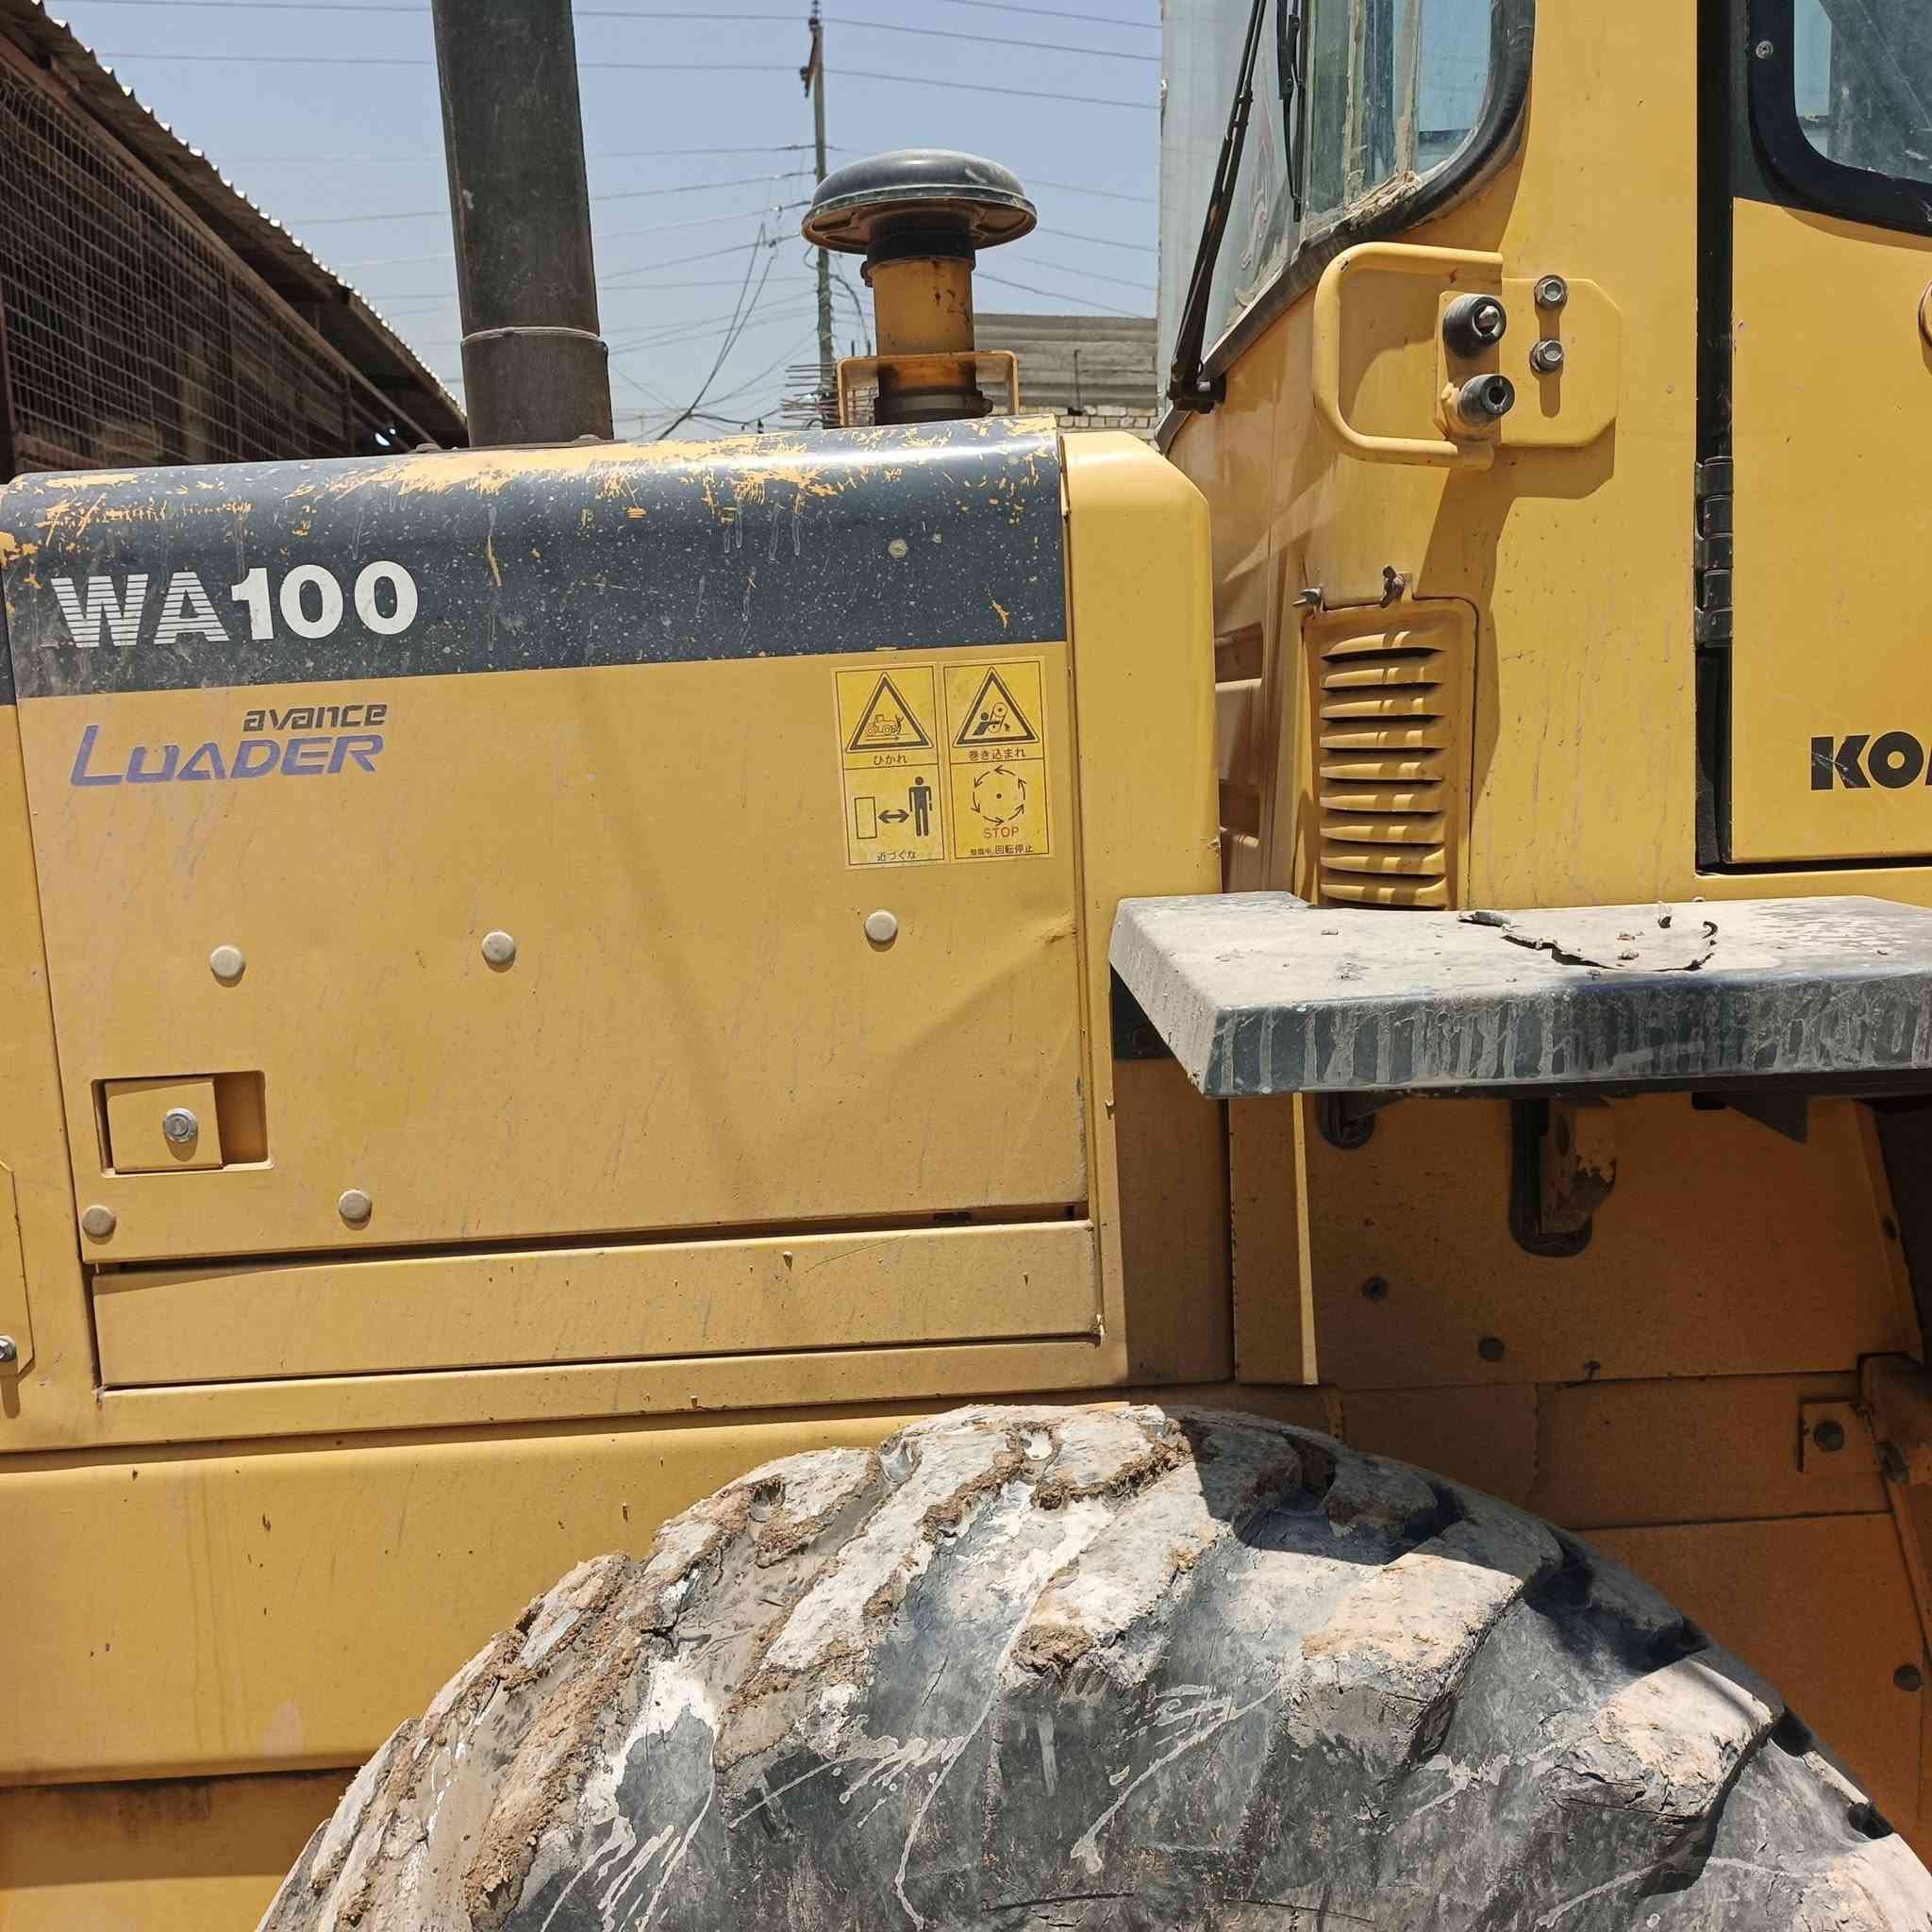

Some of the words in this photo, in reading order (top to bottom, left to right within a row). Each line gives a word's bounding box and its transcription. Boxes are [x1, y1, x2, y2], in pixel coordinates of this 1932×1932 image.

[51, 560, 418, 648] WA100
[243, 704, 387, 732] avance
[873, 754, 908, 766] ひかれ
[968, 748, 1026, 760] 巻き込まれ
[1810, 731, 1932, 791] KO
[983, 826, 1019, 839] STOP
